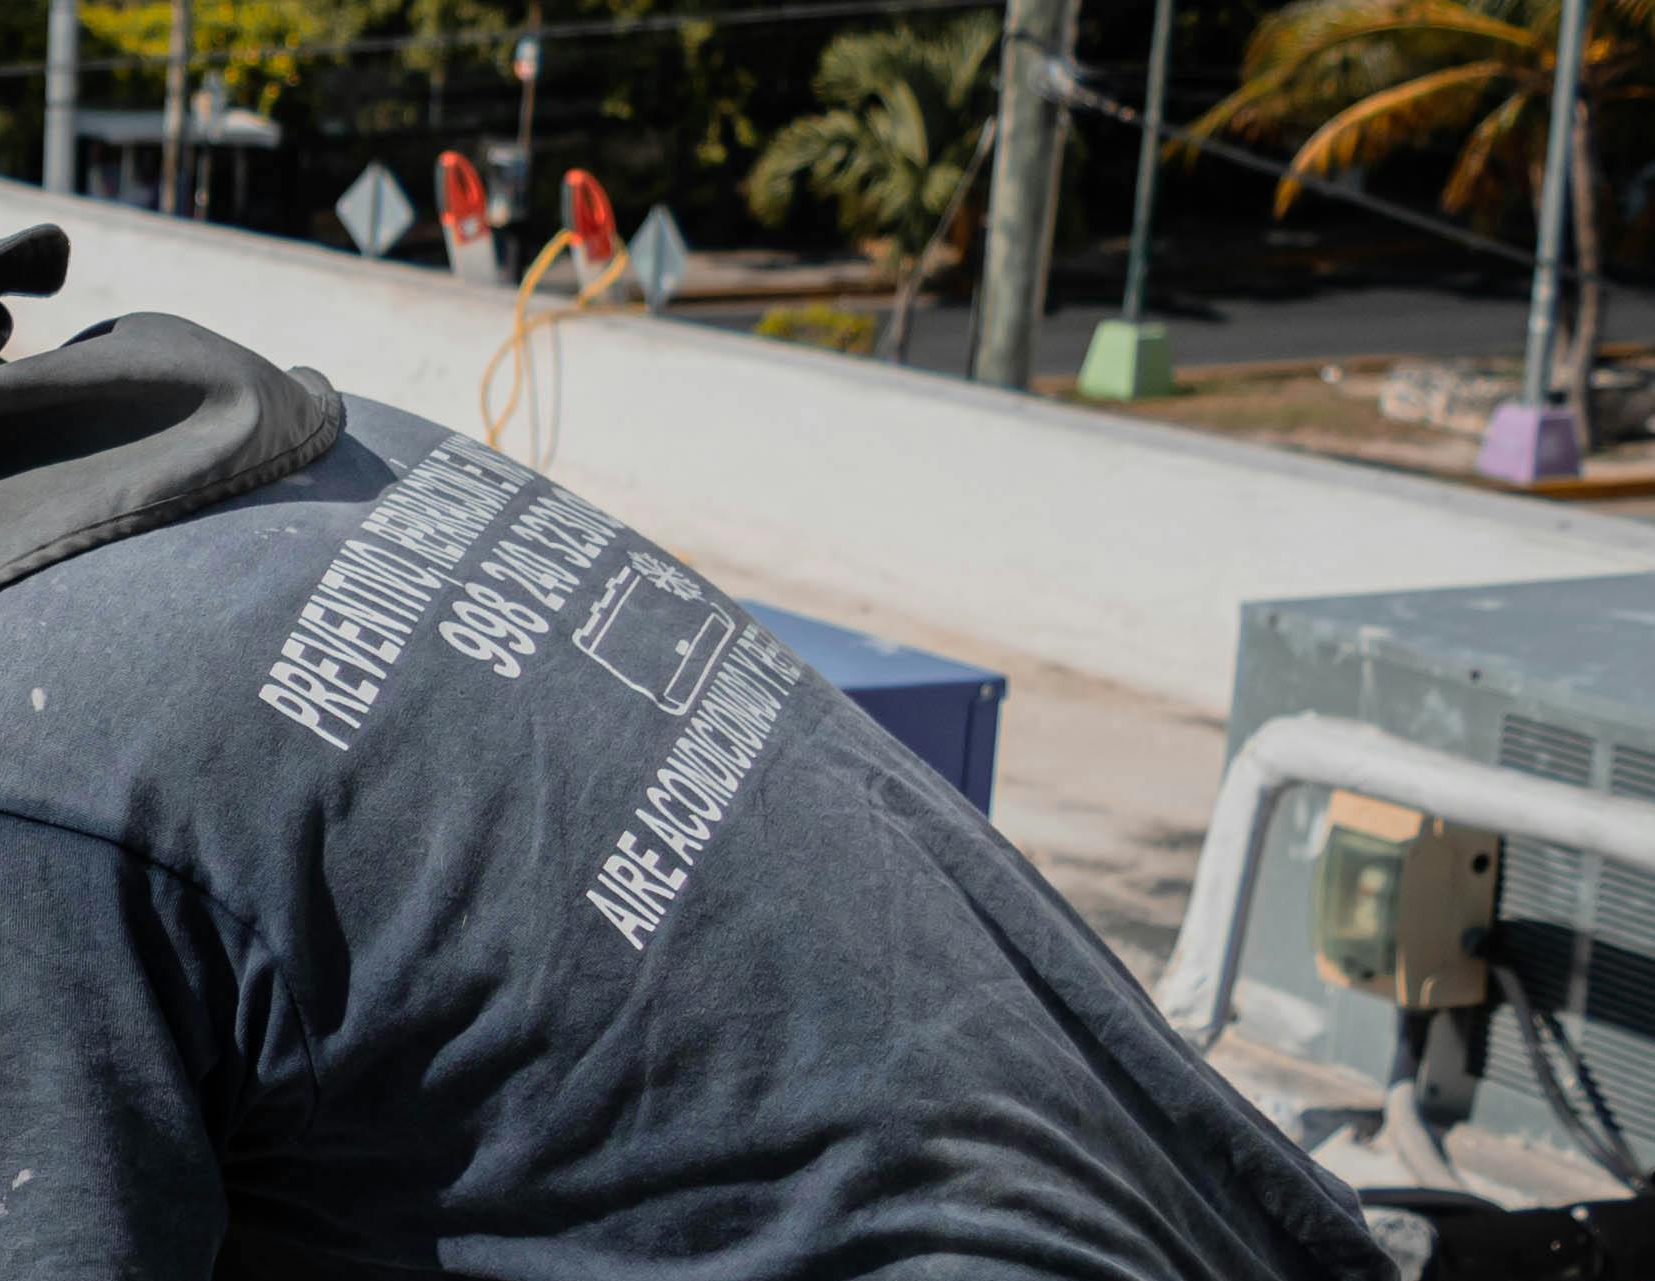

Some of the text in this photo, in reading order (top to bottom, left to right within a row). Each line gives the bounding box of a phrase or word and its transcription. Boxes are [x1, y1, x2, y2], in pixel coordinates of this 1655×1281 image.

[510, 497, 617, 569] 3230
[481, 541, 581, 612] 240
[439, 583, 549, 679] 998
[728, 646, 790, 696] Y
[635, 661, 782, 866] ACONDICIONADO
[585, 830, 688, 951] AIRE
